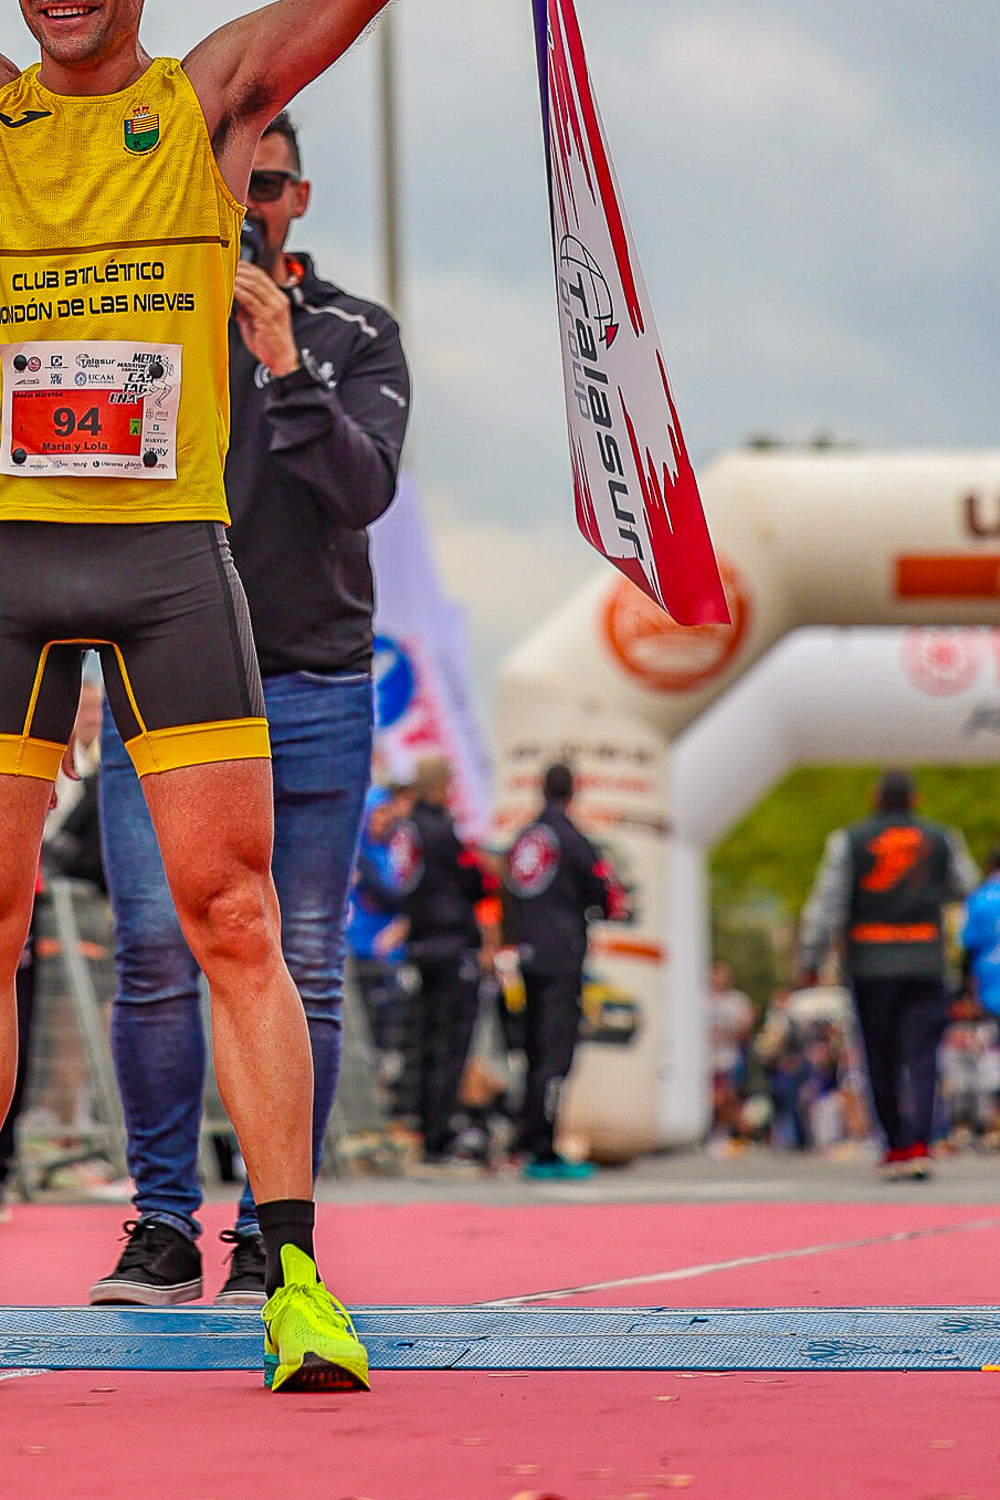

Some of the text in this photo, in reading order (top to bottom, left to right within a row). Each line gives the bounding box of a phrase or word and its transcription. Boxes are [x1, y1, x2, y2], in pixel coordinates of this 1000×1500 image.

[12, 269, 59, 292] CLUB
[88, 373, 115, 381] UCAM
[123, 382, 148, 394] TAG
[109, 393, 138, 404] ENA
[52, 406, 102, 437] 94
[566, 269, 646, 563] Talasur
[131, 426, 139, 435] A
[75, 443, 80, 453] y
[84, 441, 108, 451] Lola
